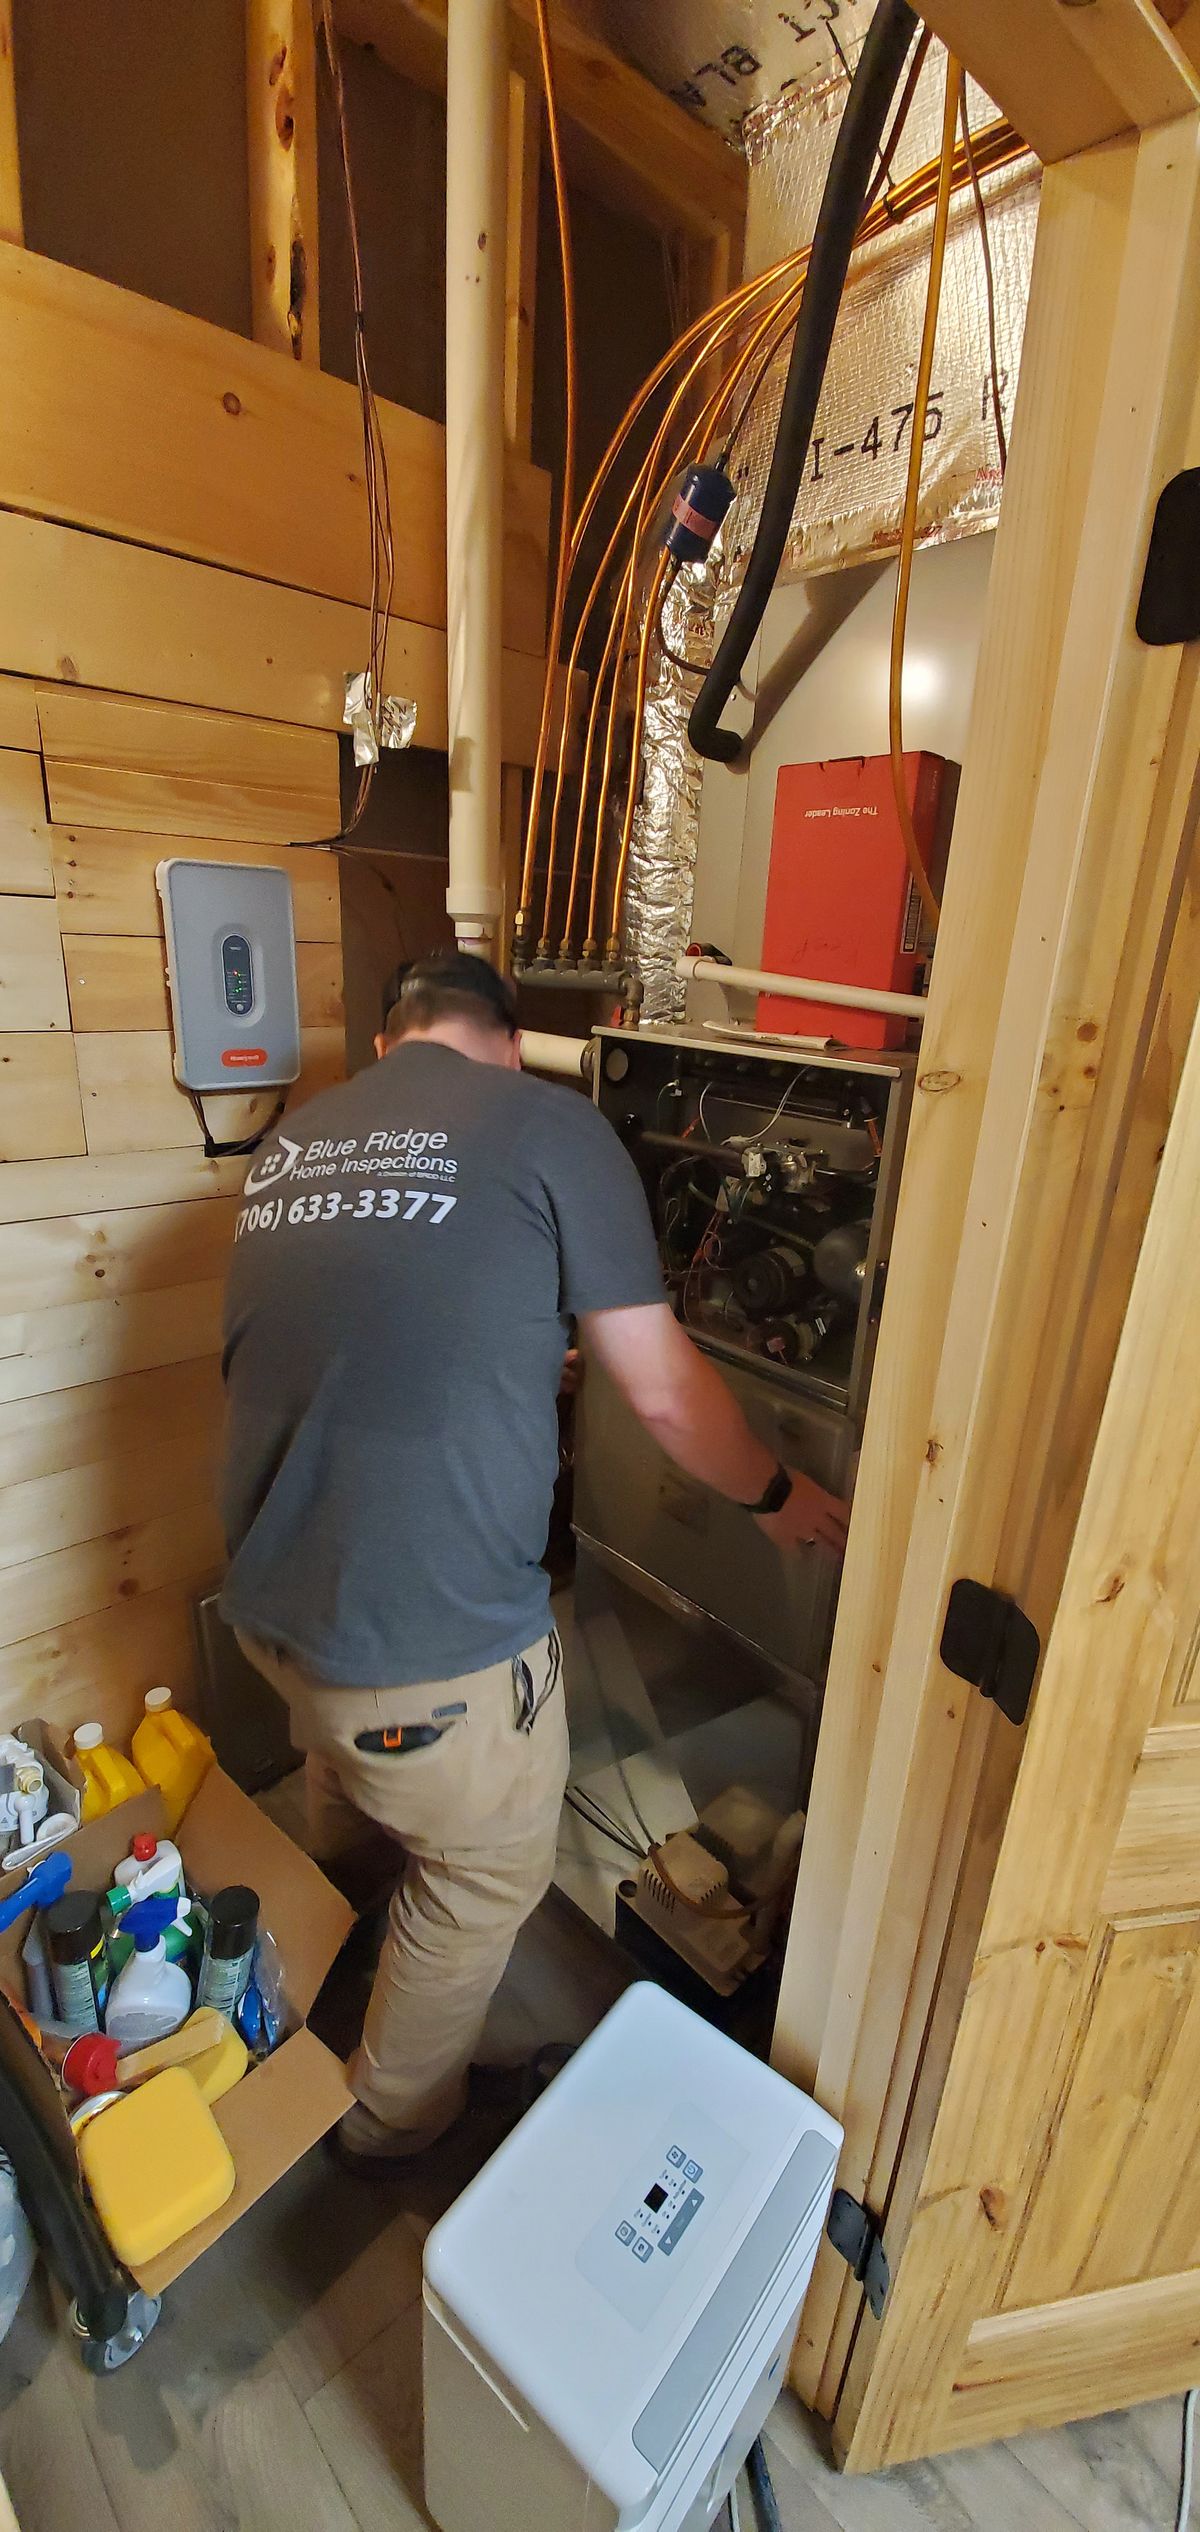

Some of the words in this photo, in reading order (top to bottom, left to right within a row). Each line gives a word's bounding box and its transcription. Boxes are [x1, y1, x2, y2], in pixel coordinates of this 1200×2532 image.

[809, 393, 944, 482] I-475
[804, 807, 831, 818] Leader
[832, 806, 861, 817] Zoning
[862, 805, 878, 817] The
[304, 1139, 357, 1162] Blue
[364, 1128, 448, 1157] Ridge
[289, 1164, 336, 1182] Home
[341, 1153, 458, 1175] Inspections
[288, 1188, 457, 1225] 633-3377
